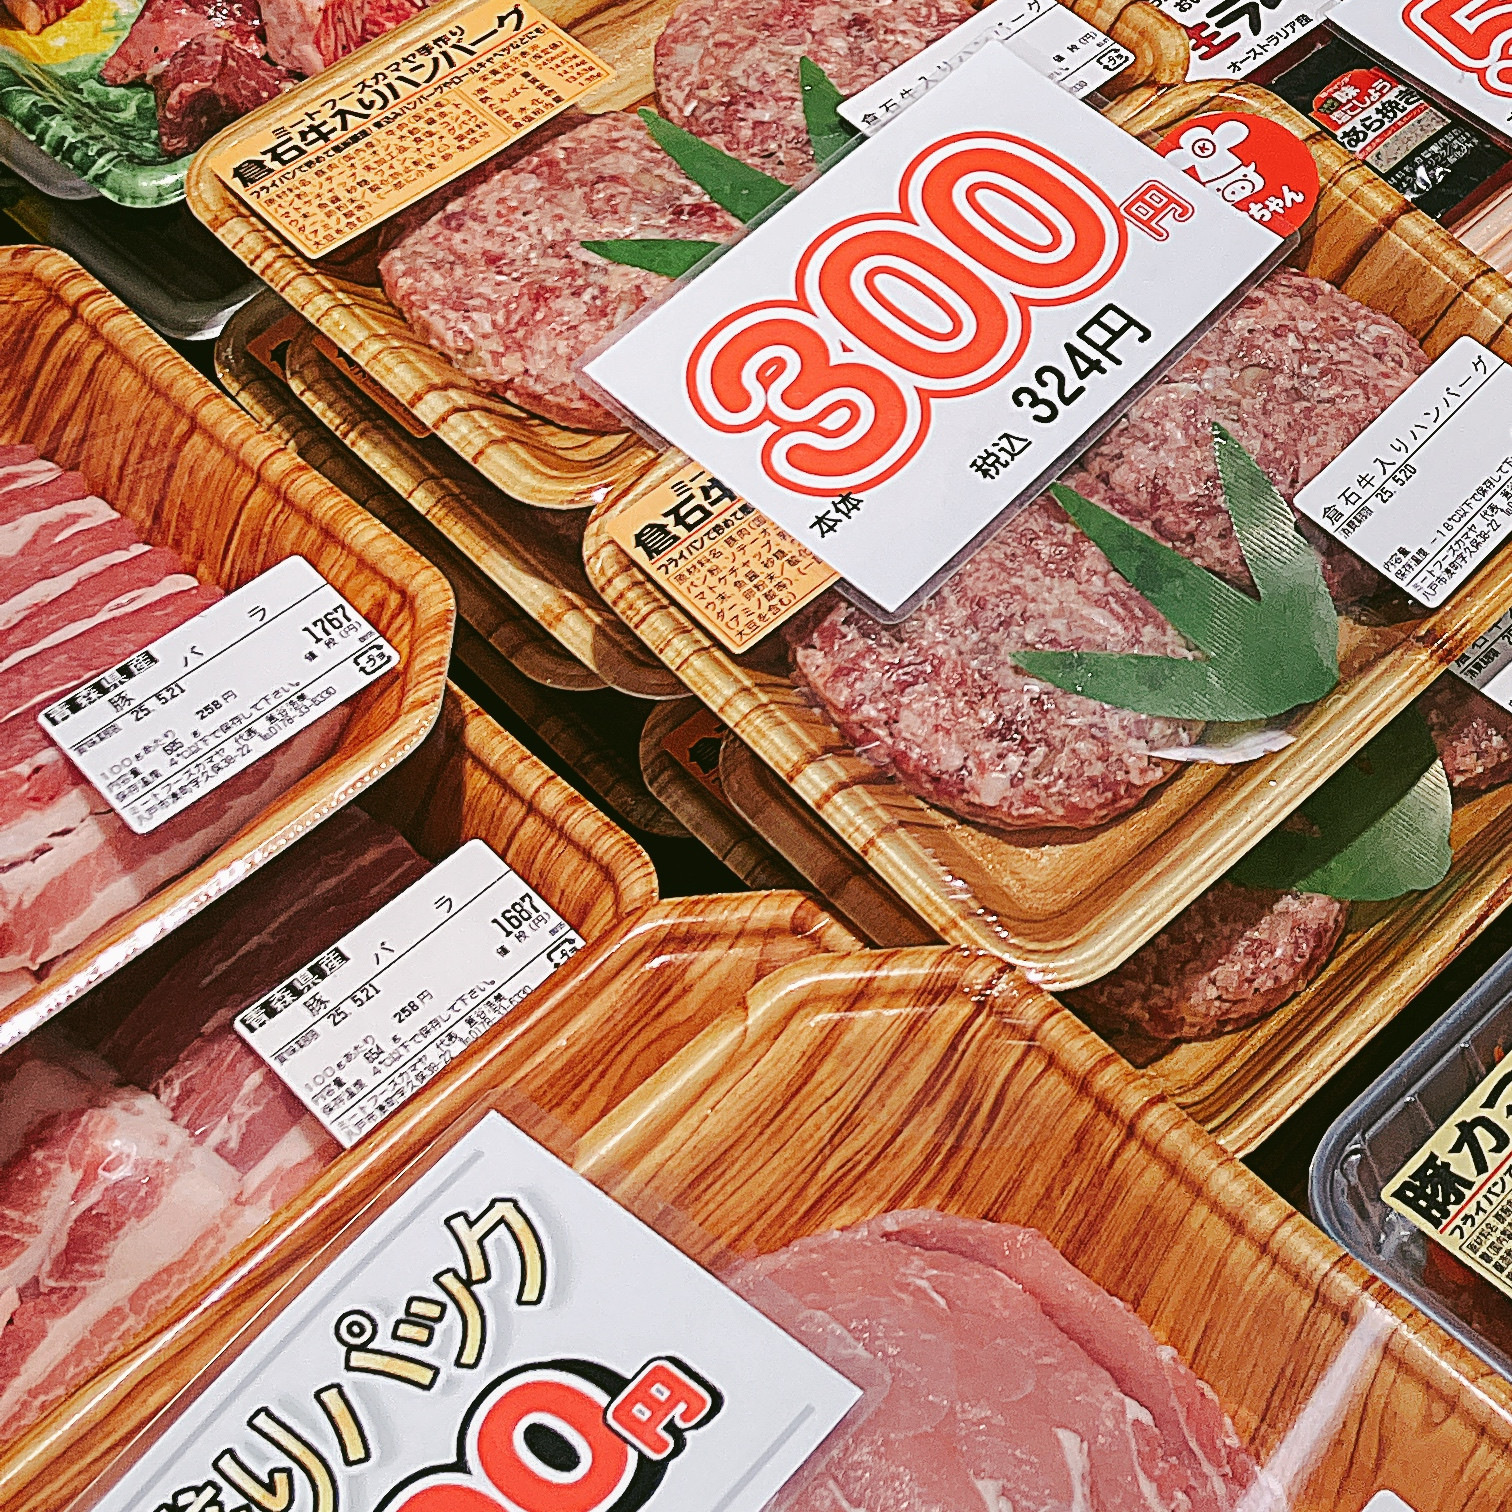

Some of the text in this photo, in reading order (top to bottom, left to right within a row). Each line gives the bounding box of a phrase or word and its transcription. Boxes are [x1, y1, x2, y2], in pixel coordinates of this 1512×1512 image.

[273, 24, 466, 138] ミートフーズカマヤ手作り
[1227, 13, 1314, 74] オーストラリア産
[231, 2, 526, 188] 倉石牛入りハンバーグ
[1337, 87, 1422, 147] あら挽き
[968, 302, 1153, 482] 税込 324円
[1320, 353, 1490, 524] 倉石牛入りハンバーグ
[808, 489, 866, 541] 本体
[1382, 543, 1413, 573] 内容量
[106, 604, 269, 710] 豚バラ
[300, 604, 350, 643] 1767
[44, 650, 159, 727] 青森県産
[304, 891, 457, 1018] 豚バラ
[490, 891, 544, 939] 1687
[240, 946, 351, 1035] 青森県産
